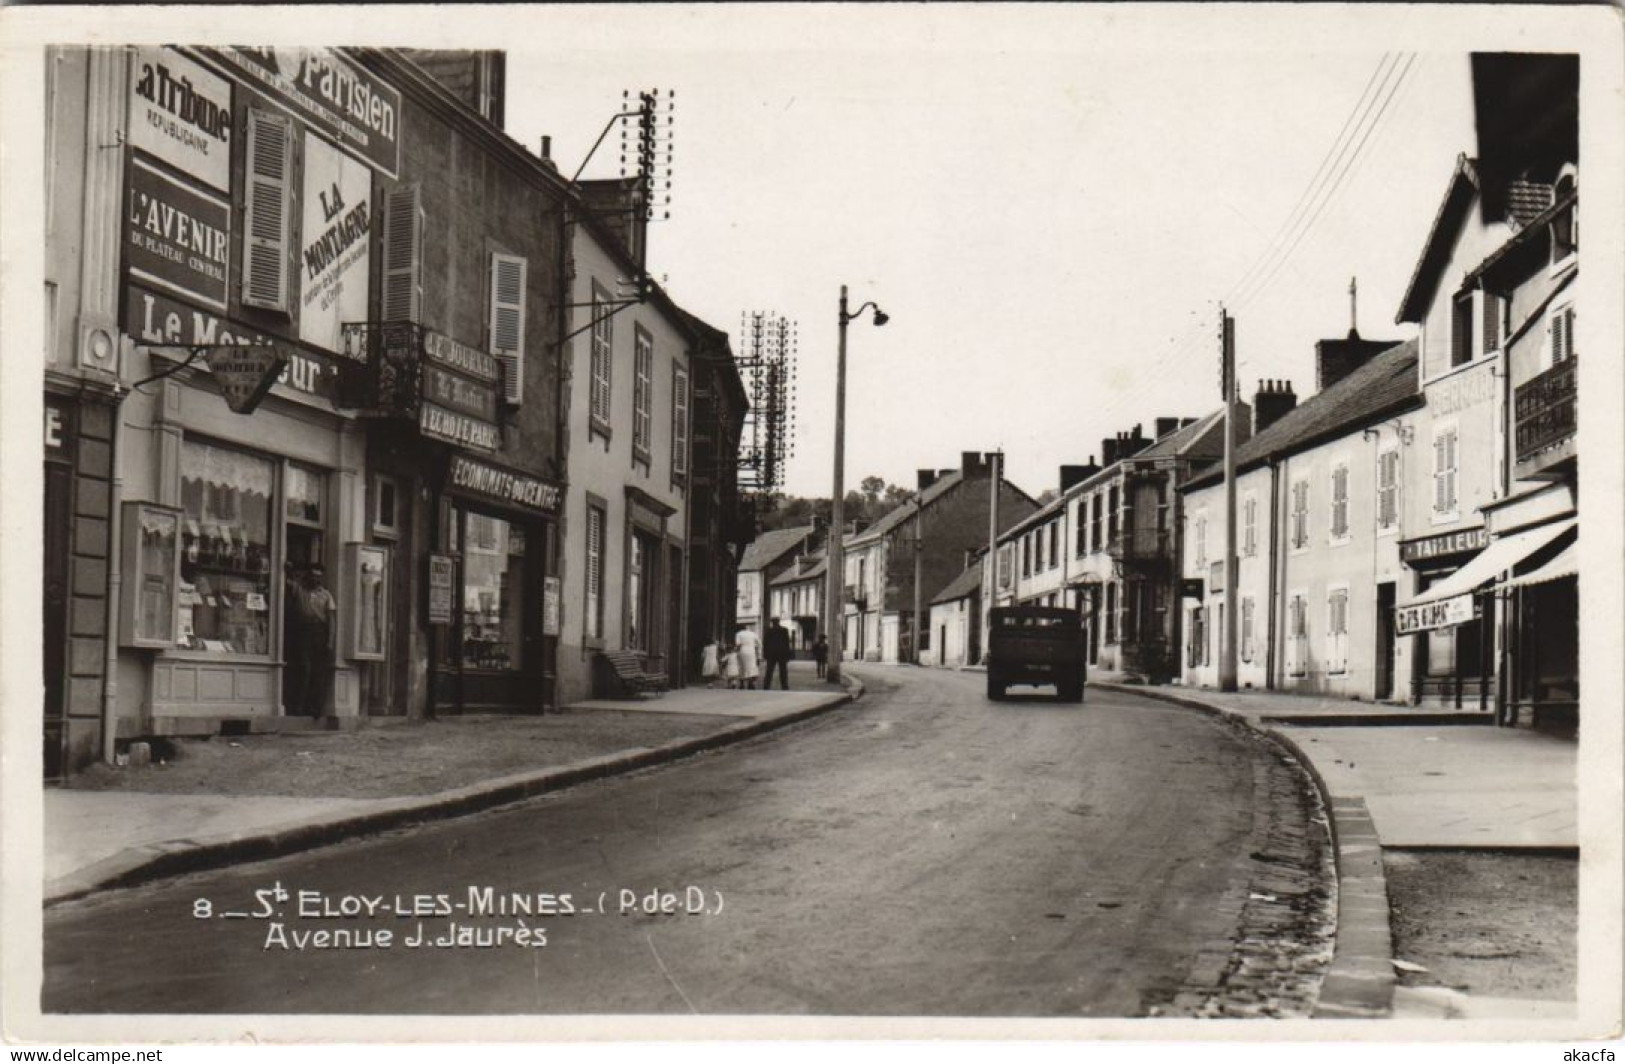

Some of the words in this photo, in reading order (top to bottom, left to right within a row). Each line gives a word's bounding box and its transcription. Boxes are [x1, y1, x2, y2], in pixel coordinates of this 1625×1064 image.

[156, 63, 230, 142] Tribune
[129, 187, 226, 263] L'AVENIR
[318, 182, 345, 223] LA
[303, 199, 370, 281] MONTAGNE
[142, 293, 182, 344] Le
[1415, 528, 1488, 557] TAILLEUR
